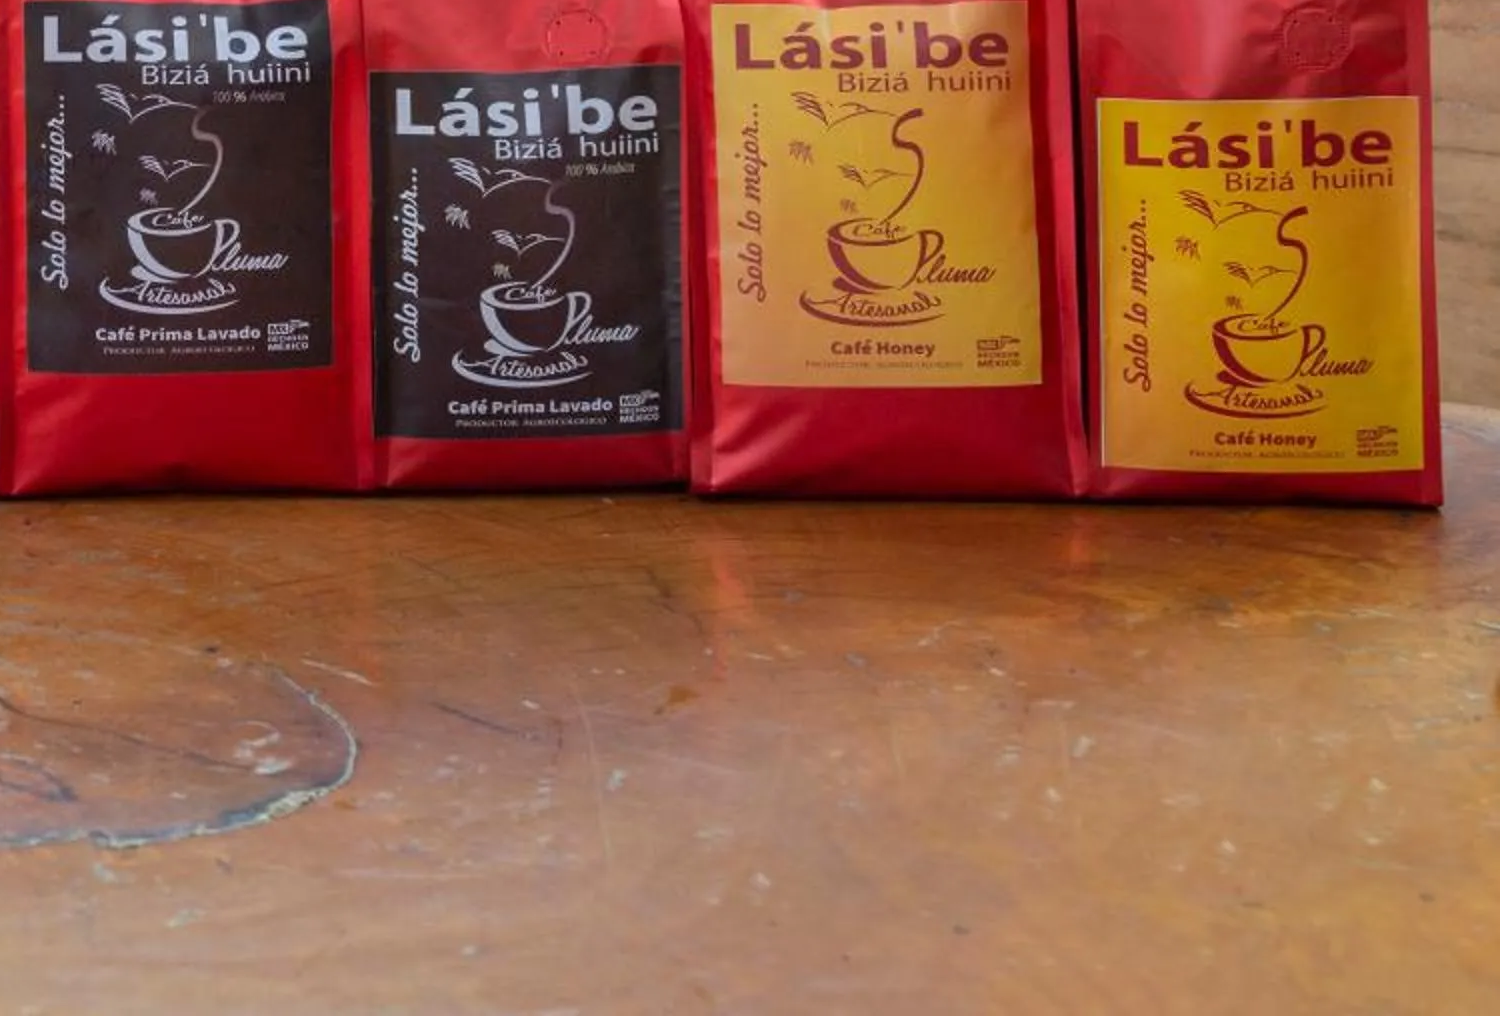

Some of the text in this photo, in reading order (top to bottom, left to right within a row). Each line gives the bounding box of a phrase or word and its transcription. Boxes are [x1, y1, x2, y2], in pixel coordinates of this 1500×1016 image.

[141, 61, 311, 86] Biziá huiini
[838, 70, 1011, 93] Biziá huiini
[494, 133, 660, 160] Biziá huiini
[1225, 168, 1394, 192] Biziá huiini
[42, 199, 66, 224] lo
[737, 212, 762, 236] lo
[211, 219, 289, 271] Pluma
[916, 230, 996, 283] Pluma
[41, 231, 69, 290] Solo
[394, 272, 419, 299] lo
[737, 245, 766, 303] Solo
[563, 291, 638, 345] Pluma
[1124, 303, 1148, 328] lo
[95, 326, 135, 341] Café
[139, 327, 193, 342] Prima
[197, 325, 261, 341] Lavado
[394, 306, 420, 364] Solo
[830, 339, 935, 358] Café Honey
[1300, 324, 1373, 376] Pluma
[1123, 334, 1151, 392] Solo
[449, 398, 487, 414] Café
[492, 399, 545, 414] Prima
[550, 398, 613, 413] Lavado
[1214, 430, 1318, 449] Café Honey
